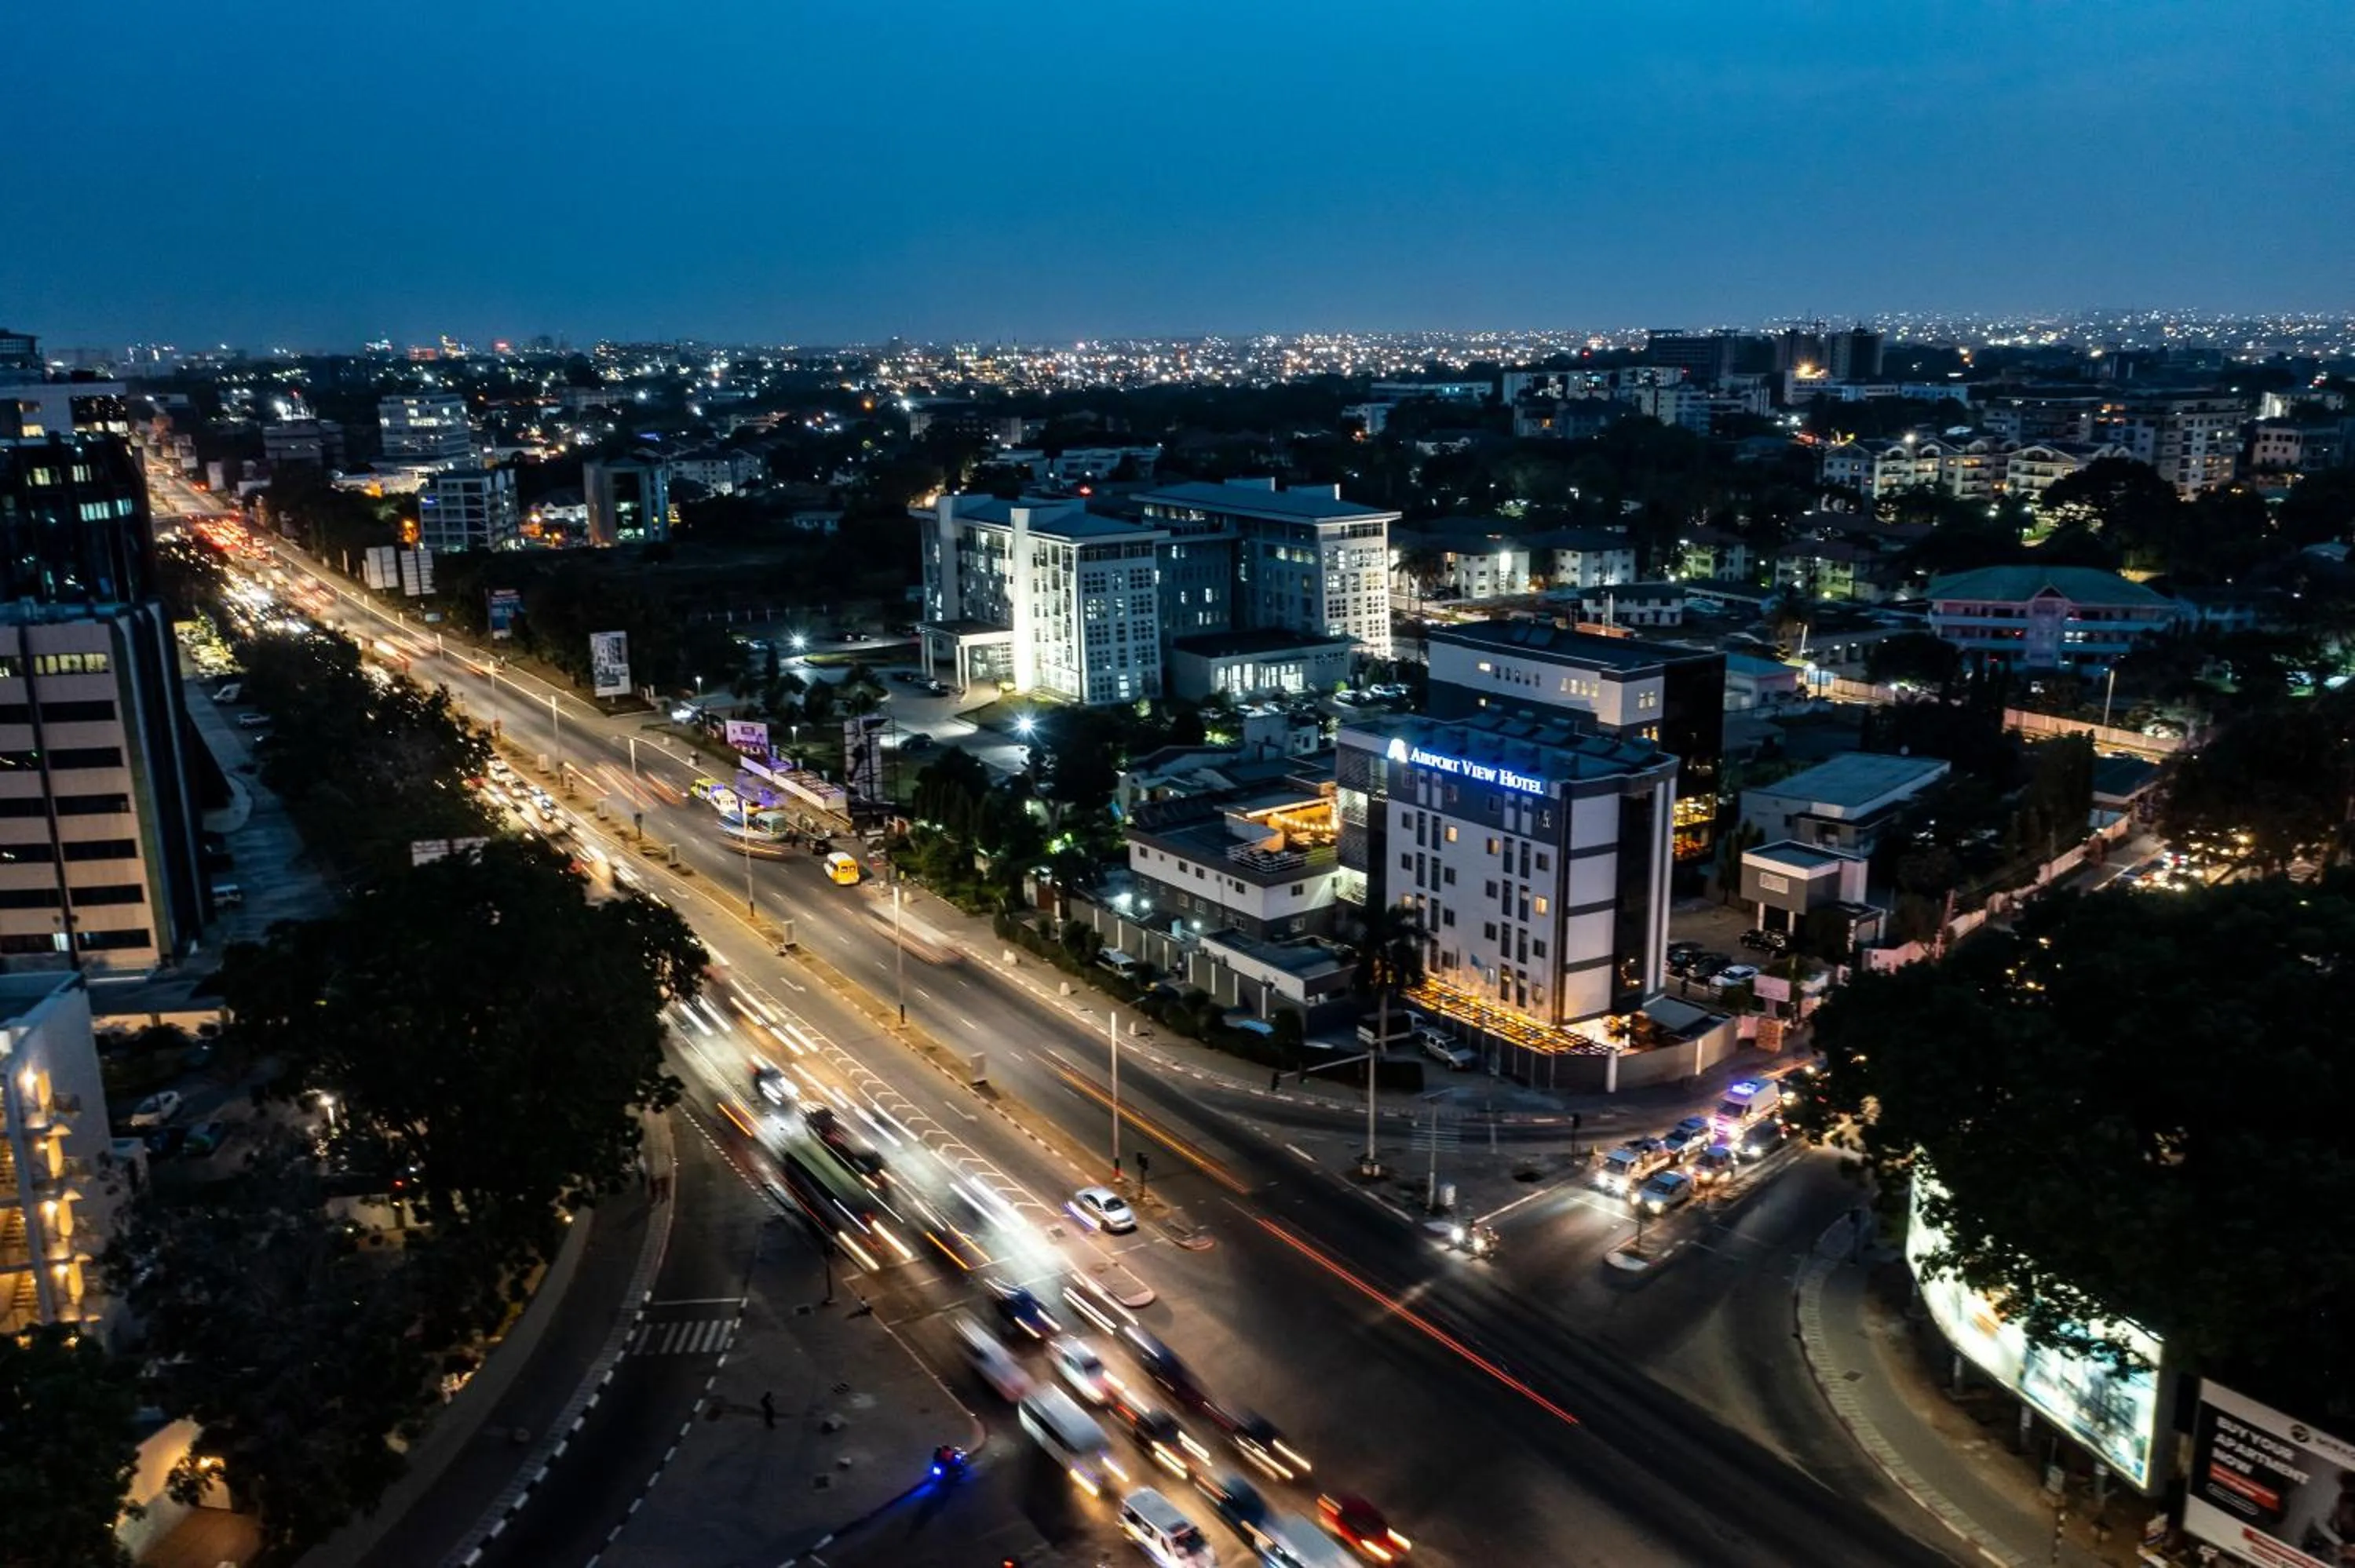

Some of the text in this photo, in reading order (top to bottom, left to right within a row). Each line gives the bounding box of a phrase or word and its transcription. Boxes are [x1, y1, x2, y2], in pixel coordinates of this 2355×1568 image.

[1410, 747, 1544, 794] AIRPORT VIEW HOTEL
[2214, 1433, 2310, 1485] APARTMENT
[2249, 1431, 2295, 1461] YOUR
